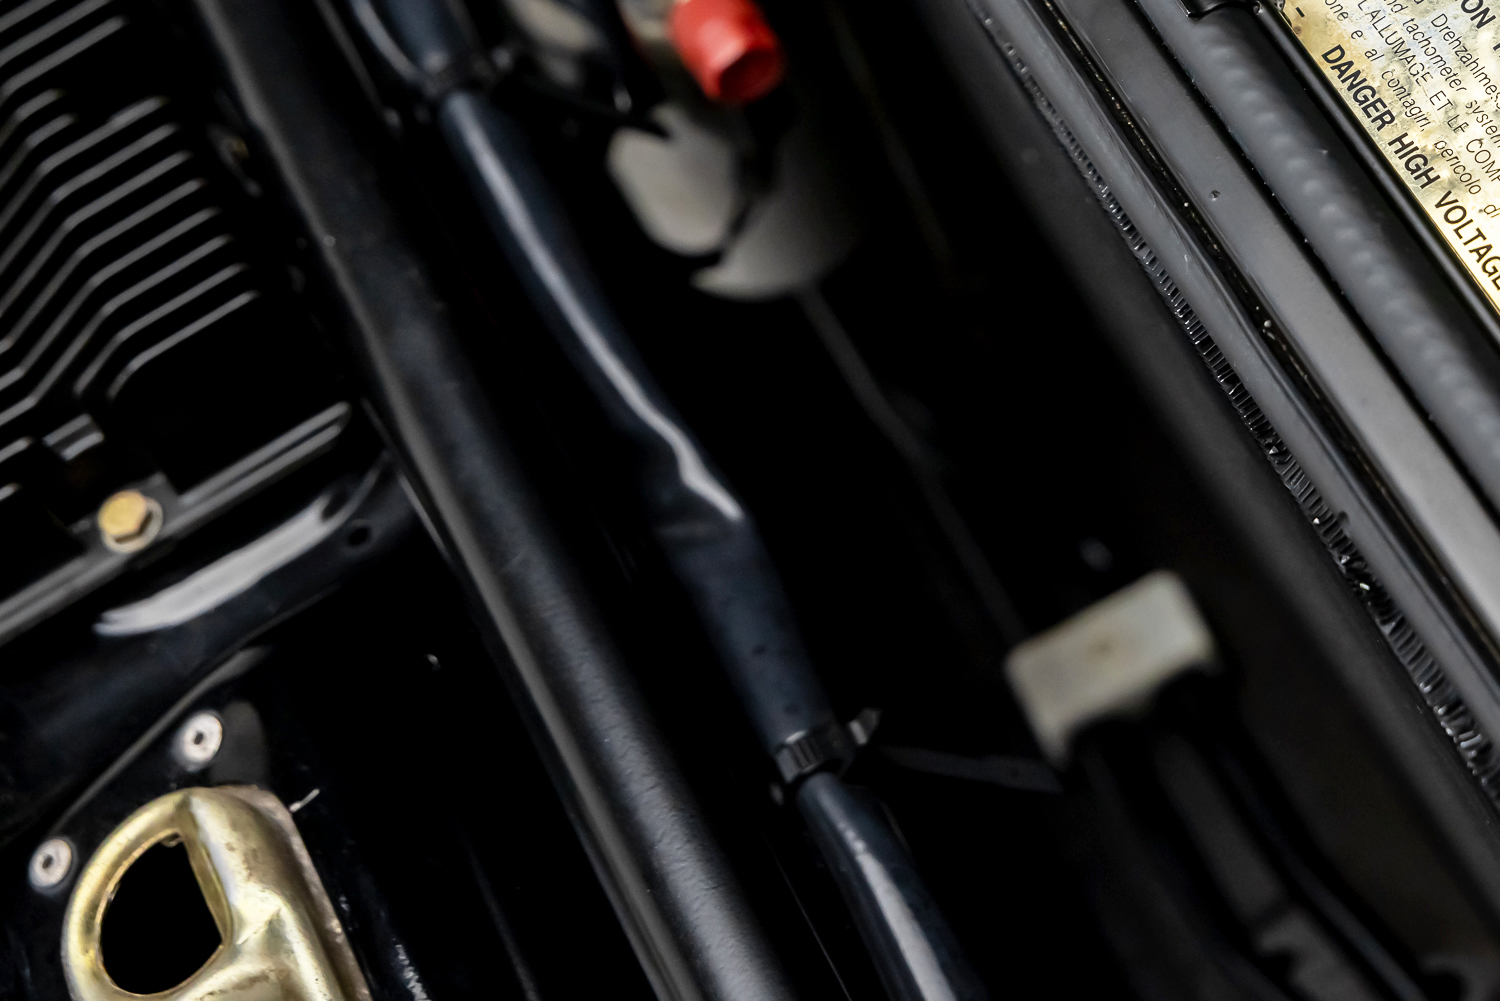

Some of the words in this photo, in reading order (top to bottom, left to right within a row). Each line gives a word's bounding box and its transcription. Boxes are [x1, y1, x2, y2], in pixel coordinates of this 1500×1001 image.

[1349, 28, 1365, 42] e
[1362, 45, 1386, 66] al
[1375, 69, 1435, 134] contagiri,
[1400, 16, 1471, 97] tachometer
[1319, 44, 1398, 132] DANGER
[1385, 132, 1442, 191] HIGH
[1427, 90, 1454, 115] ET
[1445, 114, 1471, 138] LE
